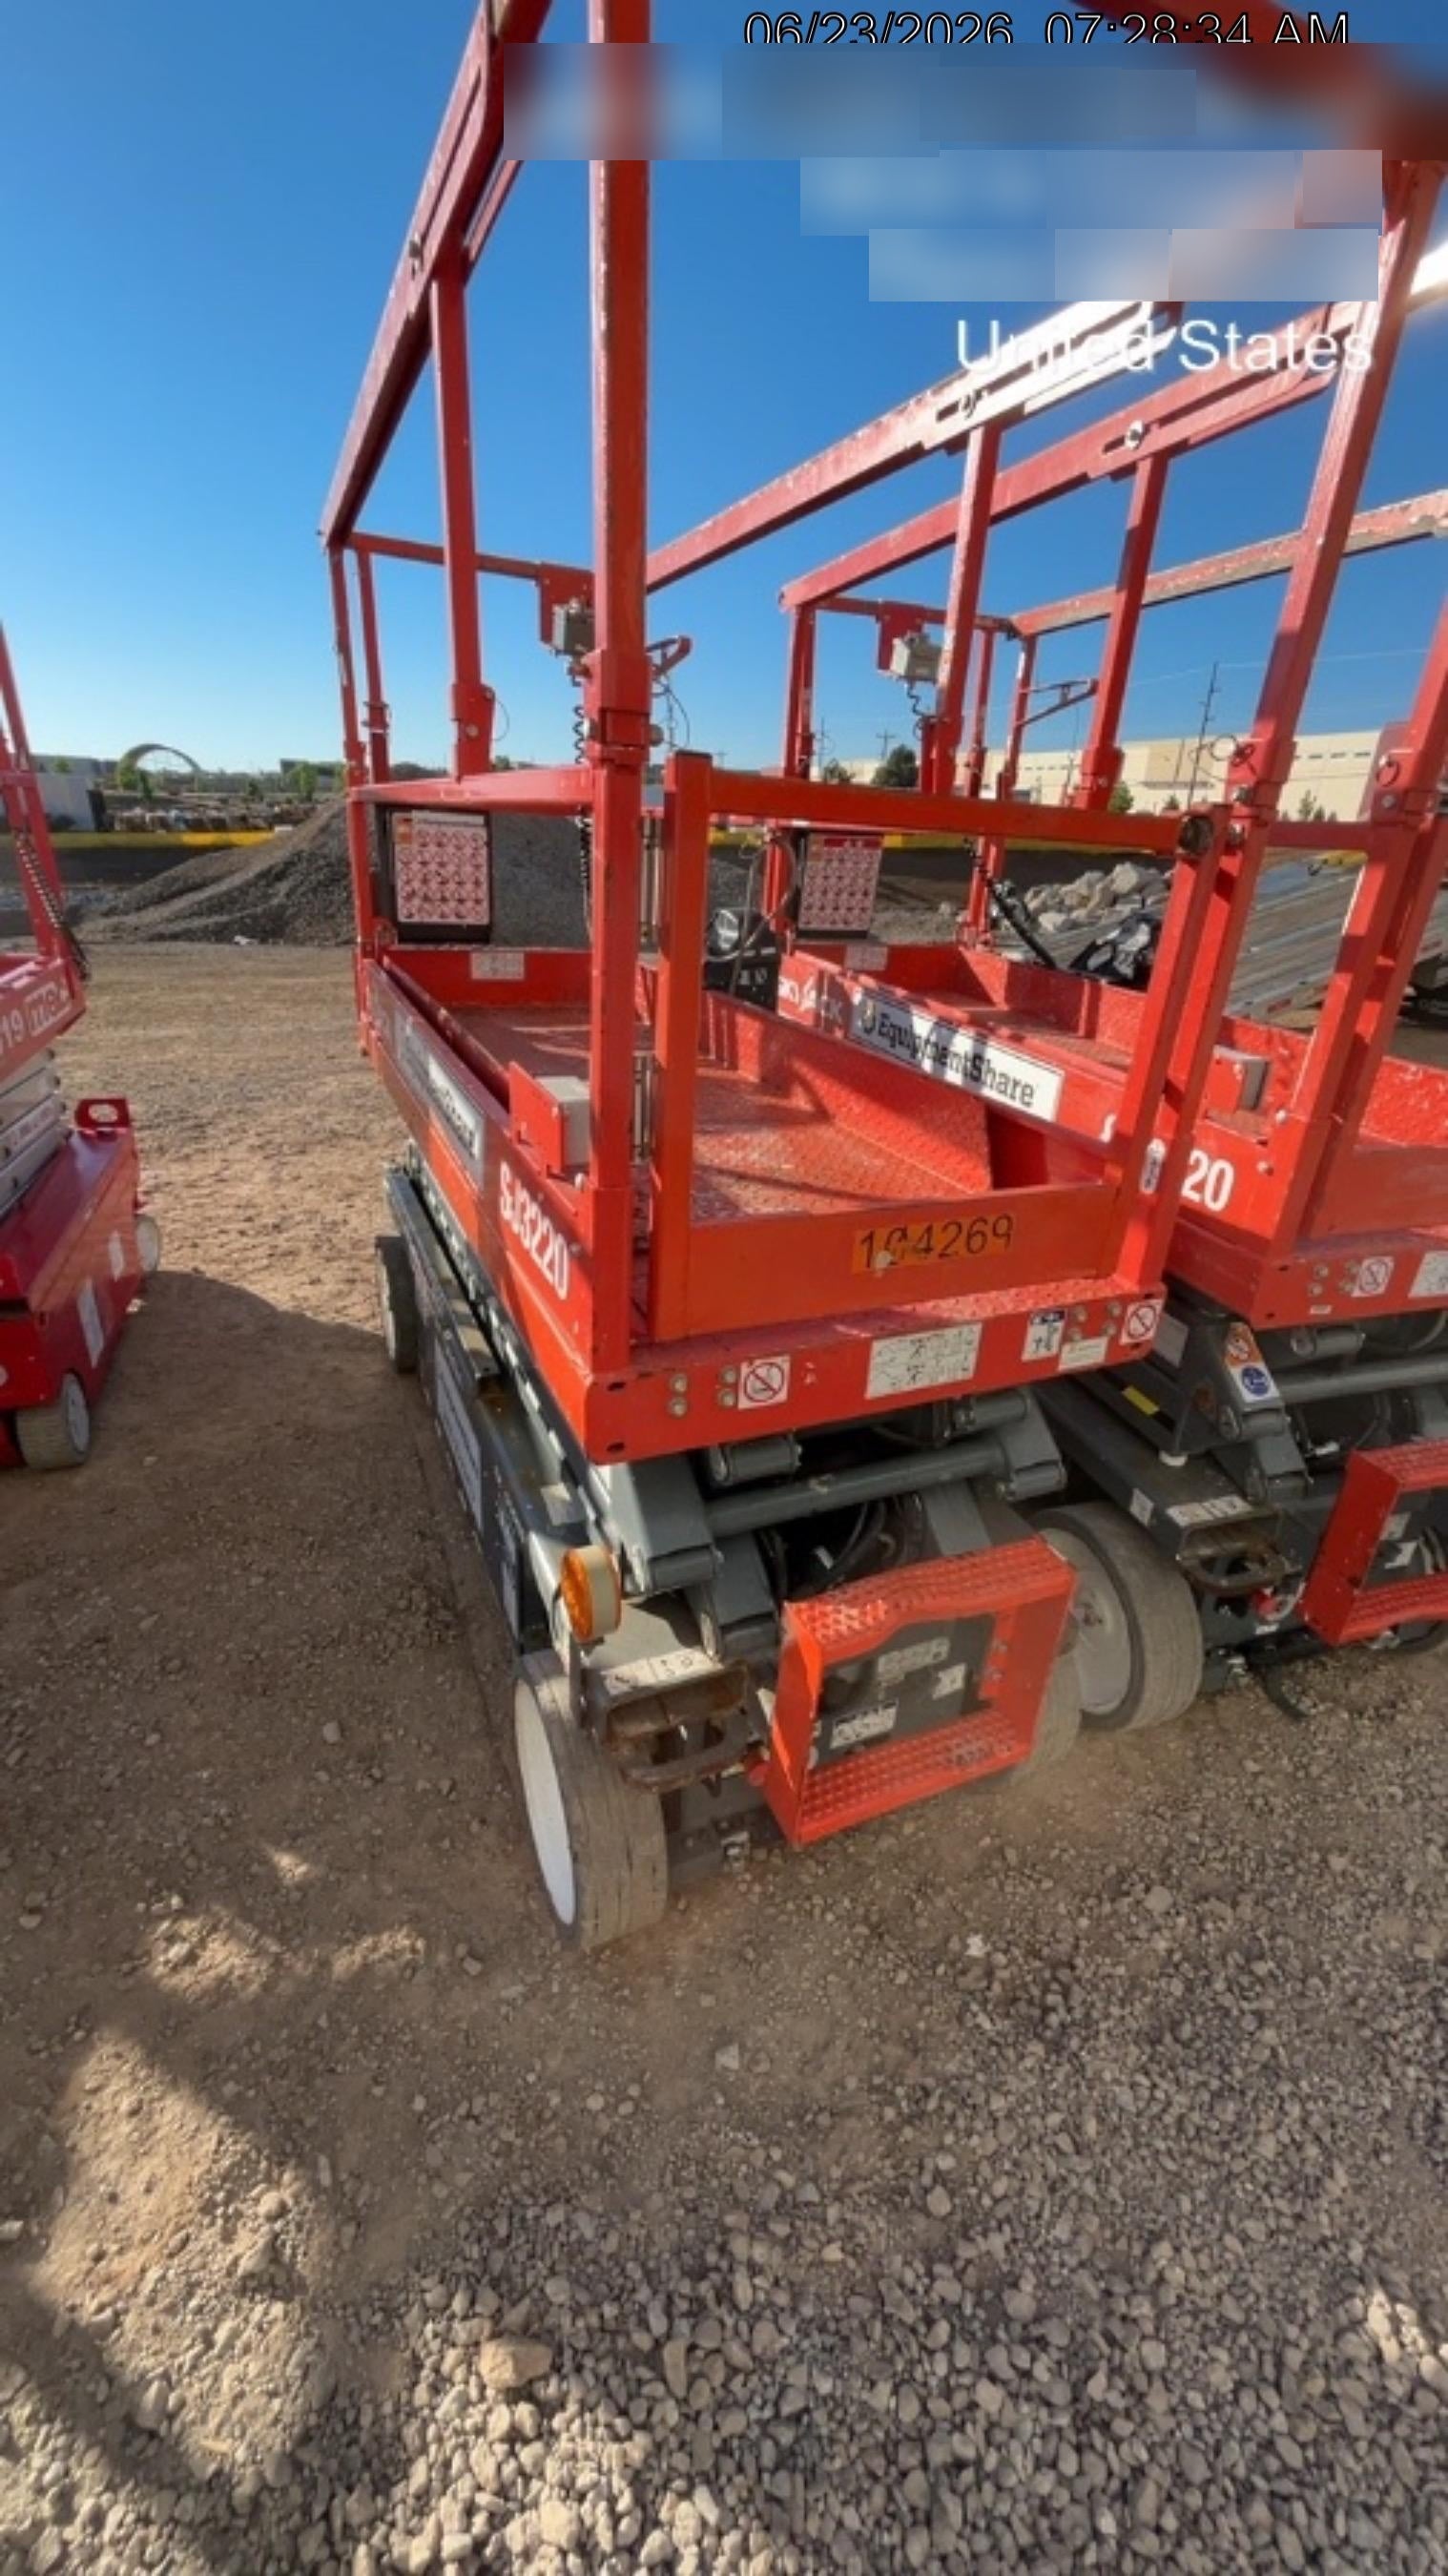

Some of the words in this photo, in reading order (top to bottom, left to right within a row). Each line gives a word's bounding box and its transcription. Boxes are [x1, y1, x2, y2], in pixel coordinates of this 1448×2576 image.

[0, 1008, 25, 1054] 19
[877, 1012, 1035, 1108] EquipmentShare
[499, 1161, 569, 1300] SJ3220
[859, 1213, 1014, 1269] 104269
